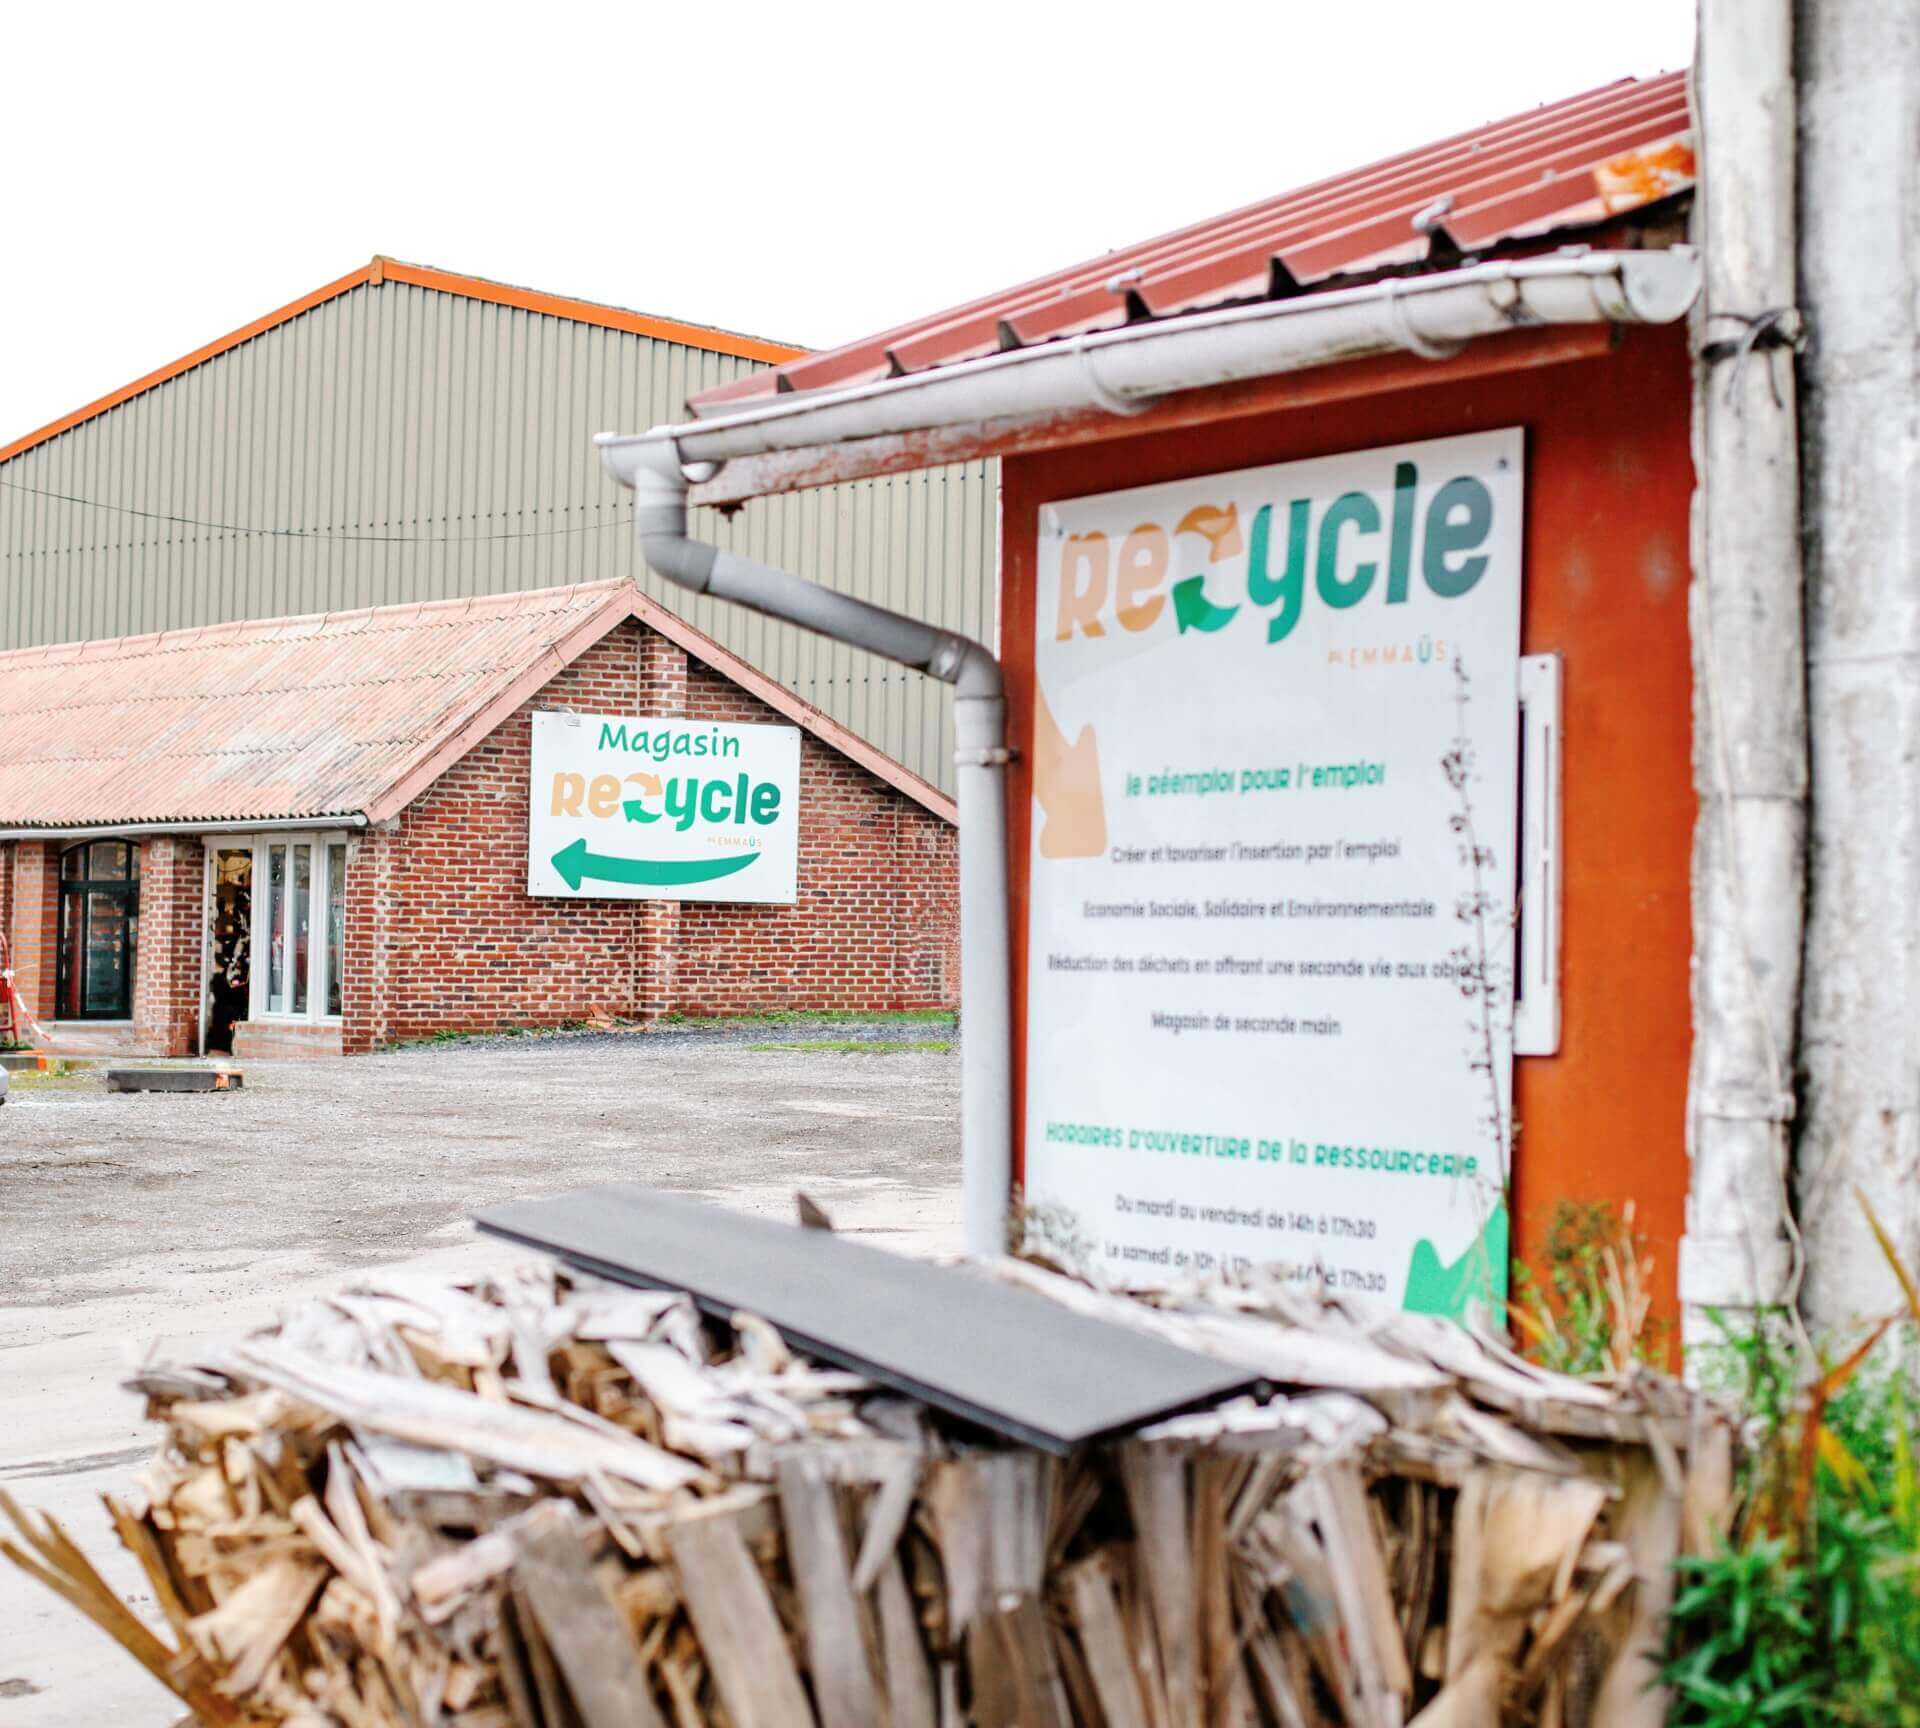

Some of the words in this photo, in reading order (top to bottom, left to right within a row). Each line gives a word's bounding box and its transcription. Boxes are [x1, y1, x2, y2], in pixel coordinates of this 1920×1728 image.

[598, 723, 740, 762] Magasin
[1307, 841, 1334, 866] par
[1267, 959, 1294, 975] une
[1299, 956, 1365, 976] seconde
[1368, 955, 1392, 976] vie
[1396, 960, 1426, 977] aux
[1151, 1012, 1211, 1036] Magasin
[1214, 1012, 1232, 1030] de
[1234, 1014, 1297, 1033] seconde
[1301, 1015, 1342, 1034] main
[1115, 1194, 1133, 1213] Du
[1137, 1198, 1177, 1217] mardi
[1180, 1204, 1197, 1219] au
[1201, 1203, 1263, 1227] vendredi
[1267, 1212, 1285, 1229] de
[1331, 1217, 1377, 1240] 17h30
[1105, 1242, 1118, 1258] Le
[1122, 1245, 1171, 1265] samedi
[1341, 1269, 1387, 1292] 17h30
